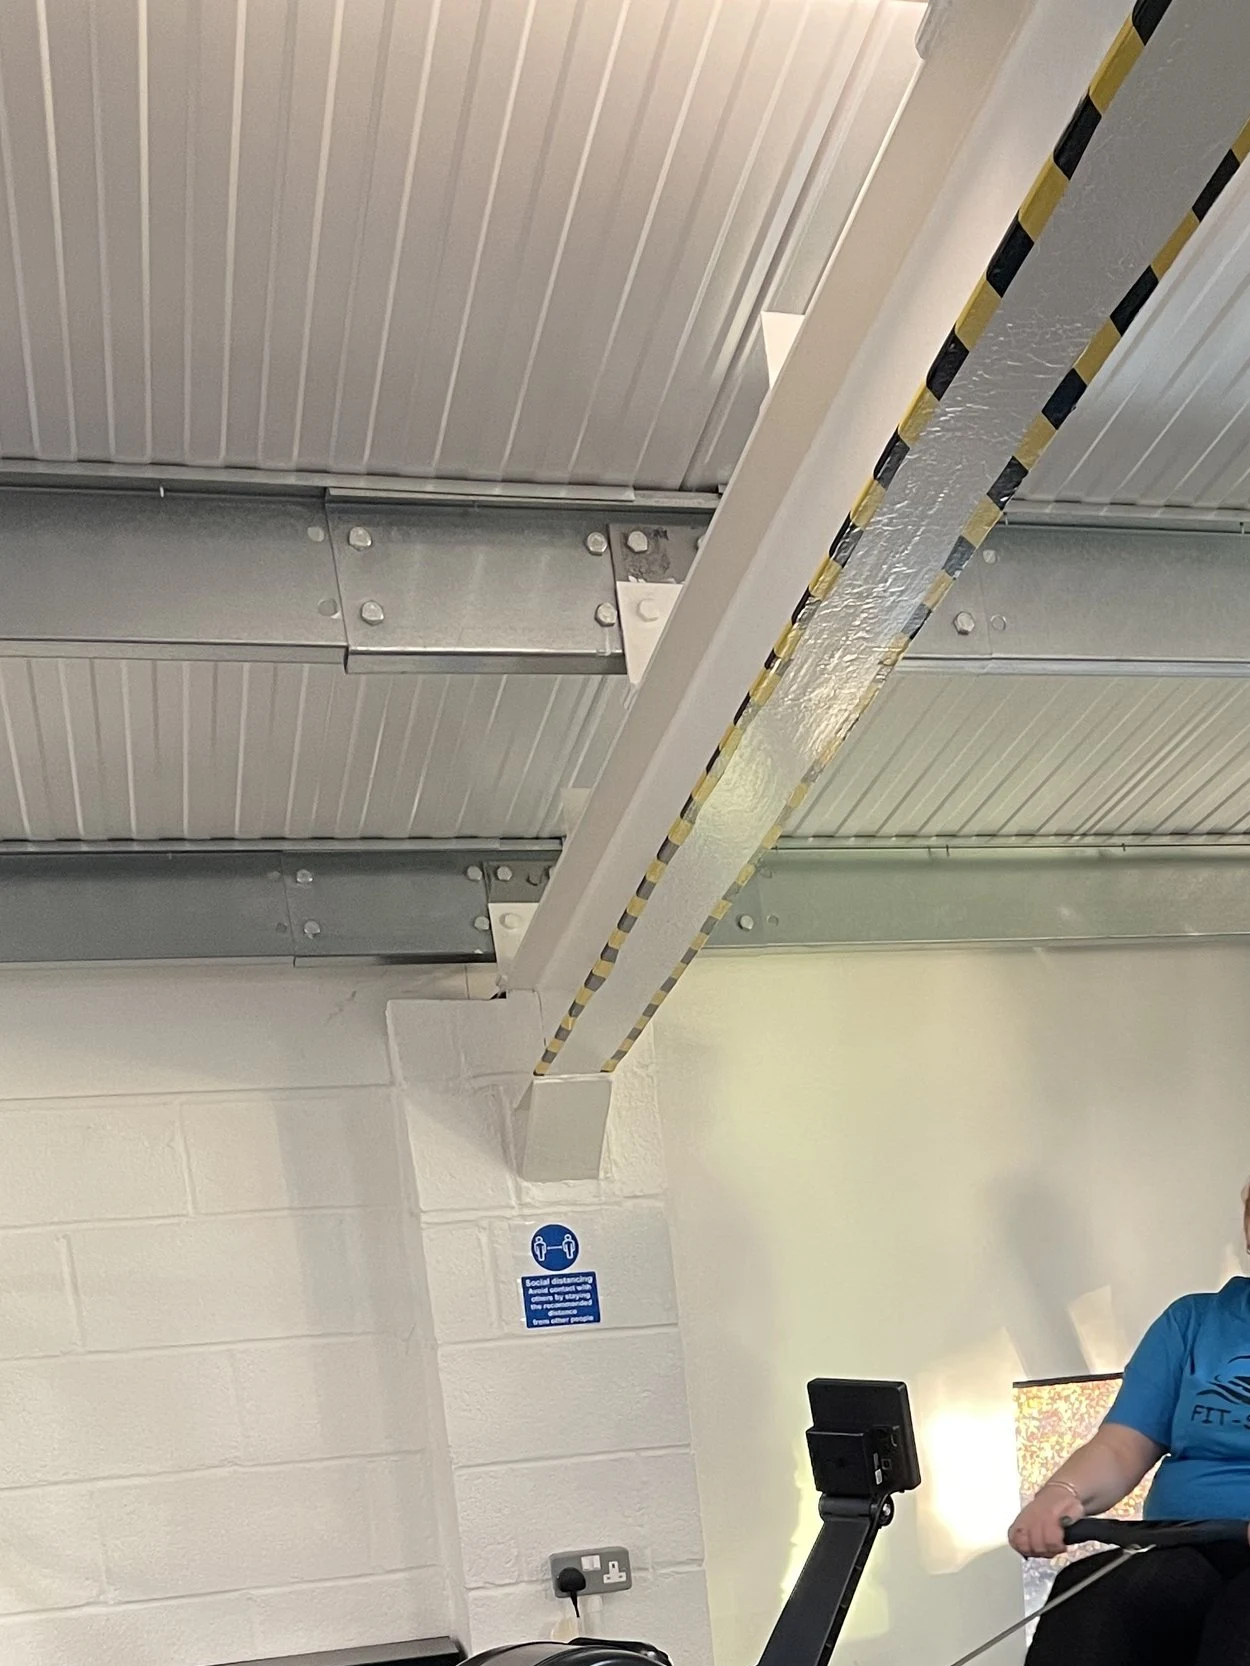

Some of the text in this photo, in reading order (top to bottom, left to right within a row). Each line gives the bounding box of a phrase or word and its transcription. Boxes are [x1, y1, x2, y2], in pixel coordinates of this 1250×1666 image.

[525, 1275, 593, 1287] Social distancing
[528, 1287, 549, 1295] Avoid
[549, 1285, 576, 1293] contact
[555, 1293, 564, 1301] by
[565, 1291, 591, 1300] staying
[543, 1299, 593, 1309] recommended
[548, 1309, 577, 1317] distance
[551, 1316, 570, 1324] other
